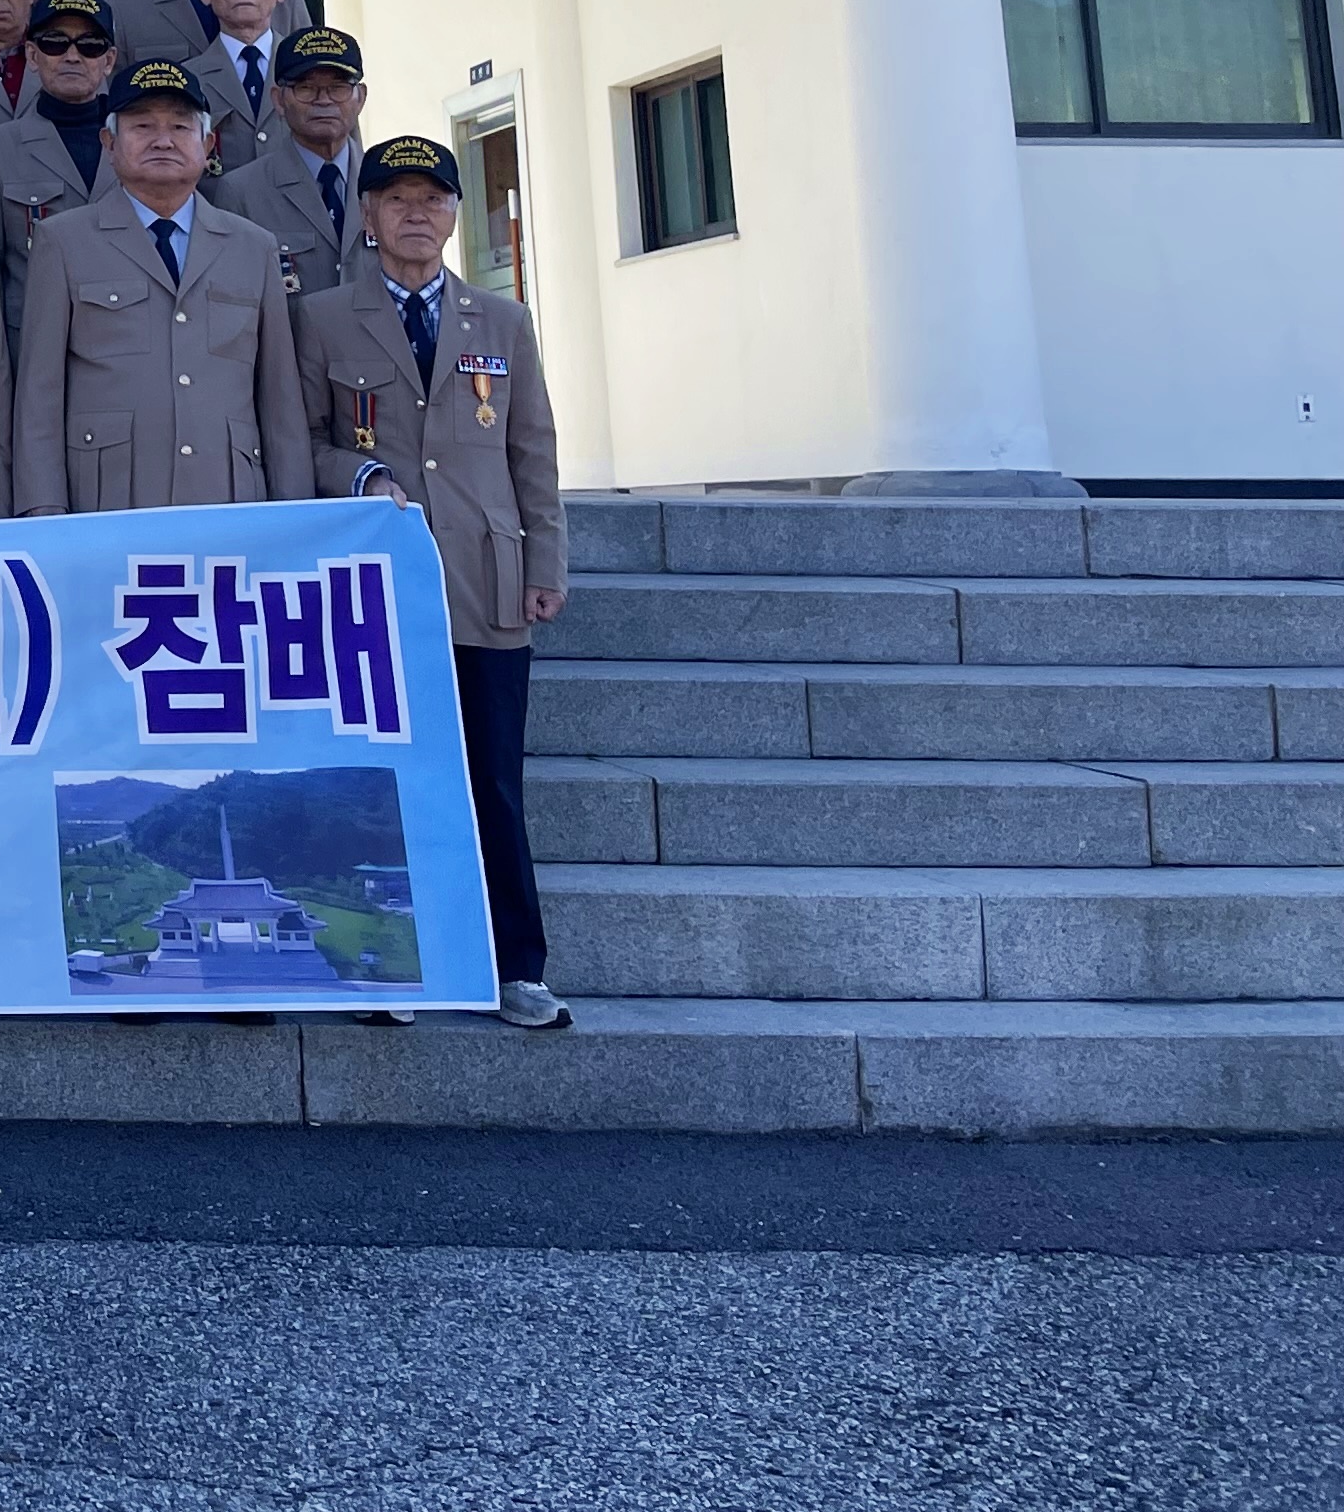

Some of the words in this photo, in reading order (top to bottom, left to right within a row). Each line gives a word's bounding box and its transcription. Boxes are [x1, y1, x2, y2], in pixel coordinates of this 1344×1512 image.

[130, 62, 170, 85] VIETNAM
[139, 80, 184, 89] VETERANS
[380, 139, 421, 163] VIETNAM
[388, 158, 434, 168] VETERANS
[115, 561, 402, 735] 참배
